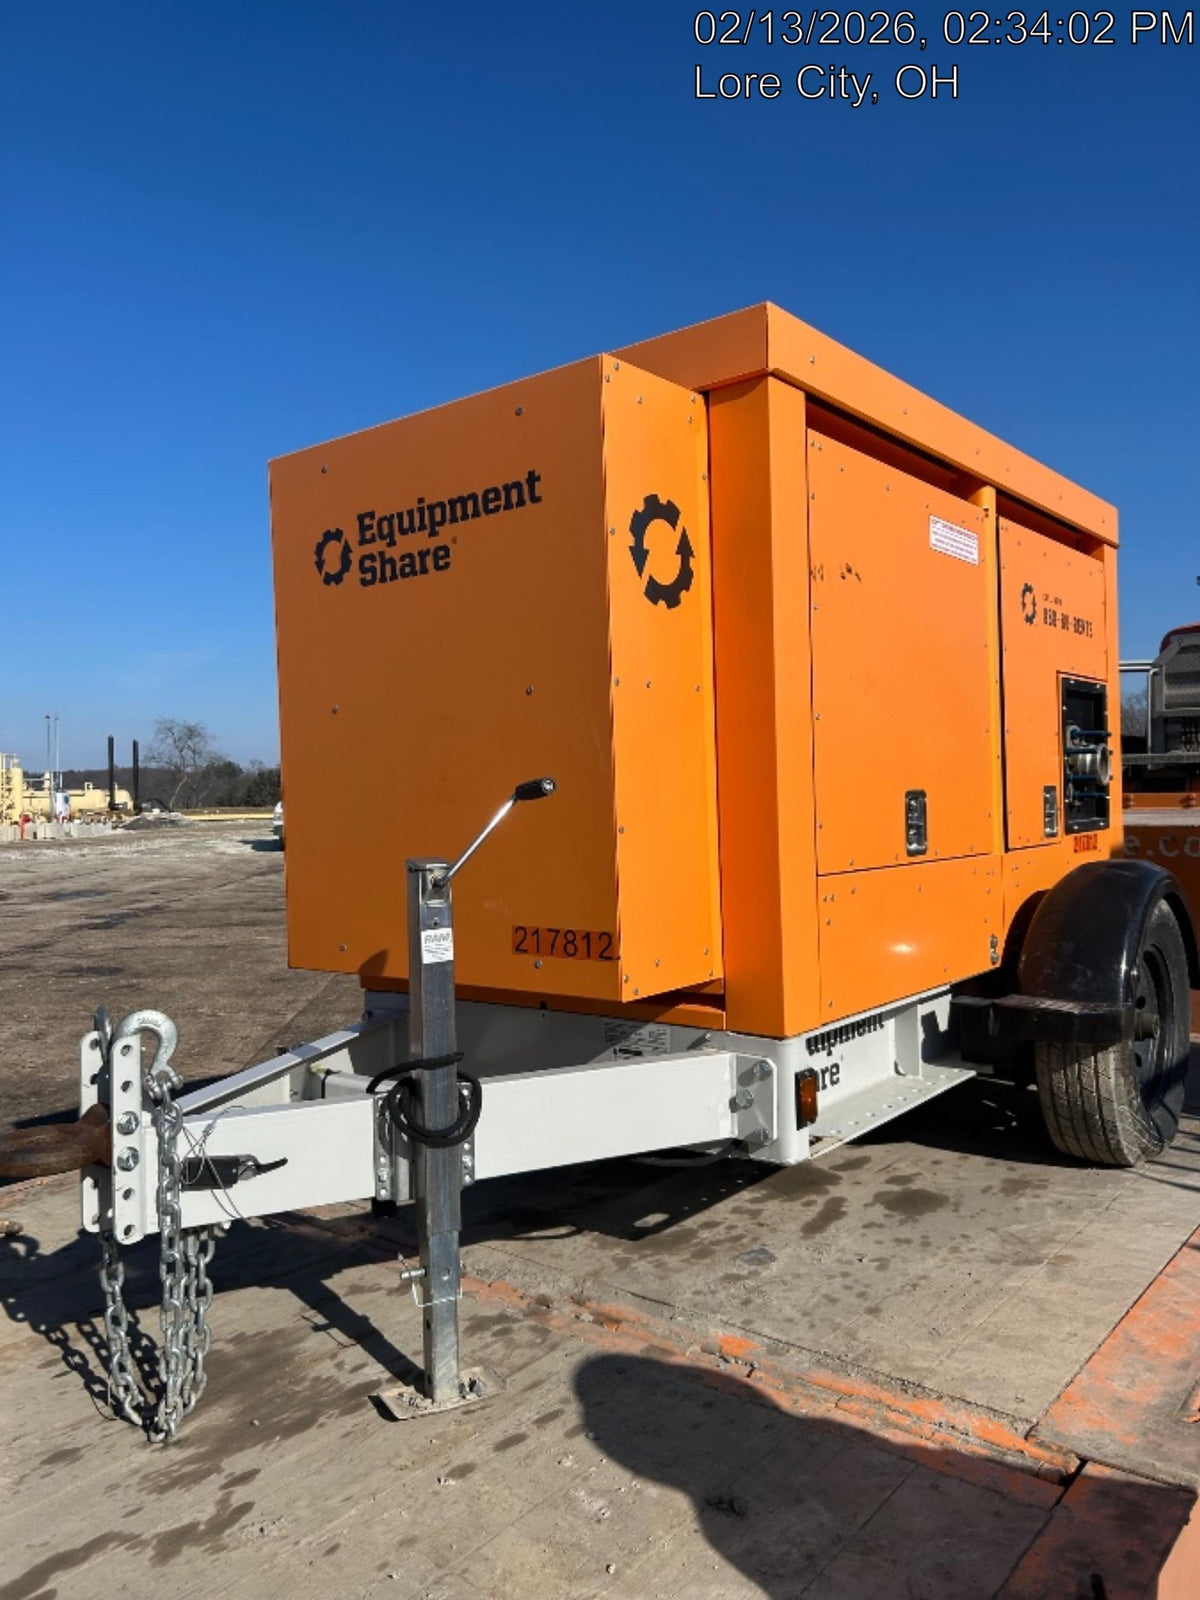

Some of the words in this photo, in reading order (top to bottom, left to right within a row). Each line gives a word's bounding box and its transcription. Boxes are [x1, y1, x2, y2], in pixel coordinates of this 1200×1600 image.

[357, 469, 542, 547] Equipment
[358, 544, 451, 587] Share
[514, 925, 613, 961] 217812
